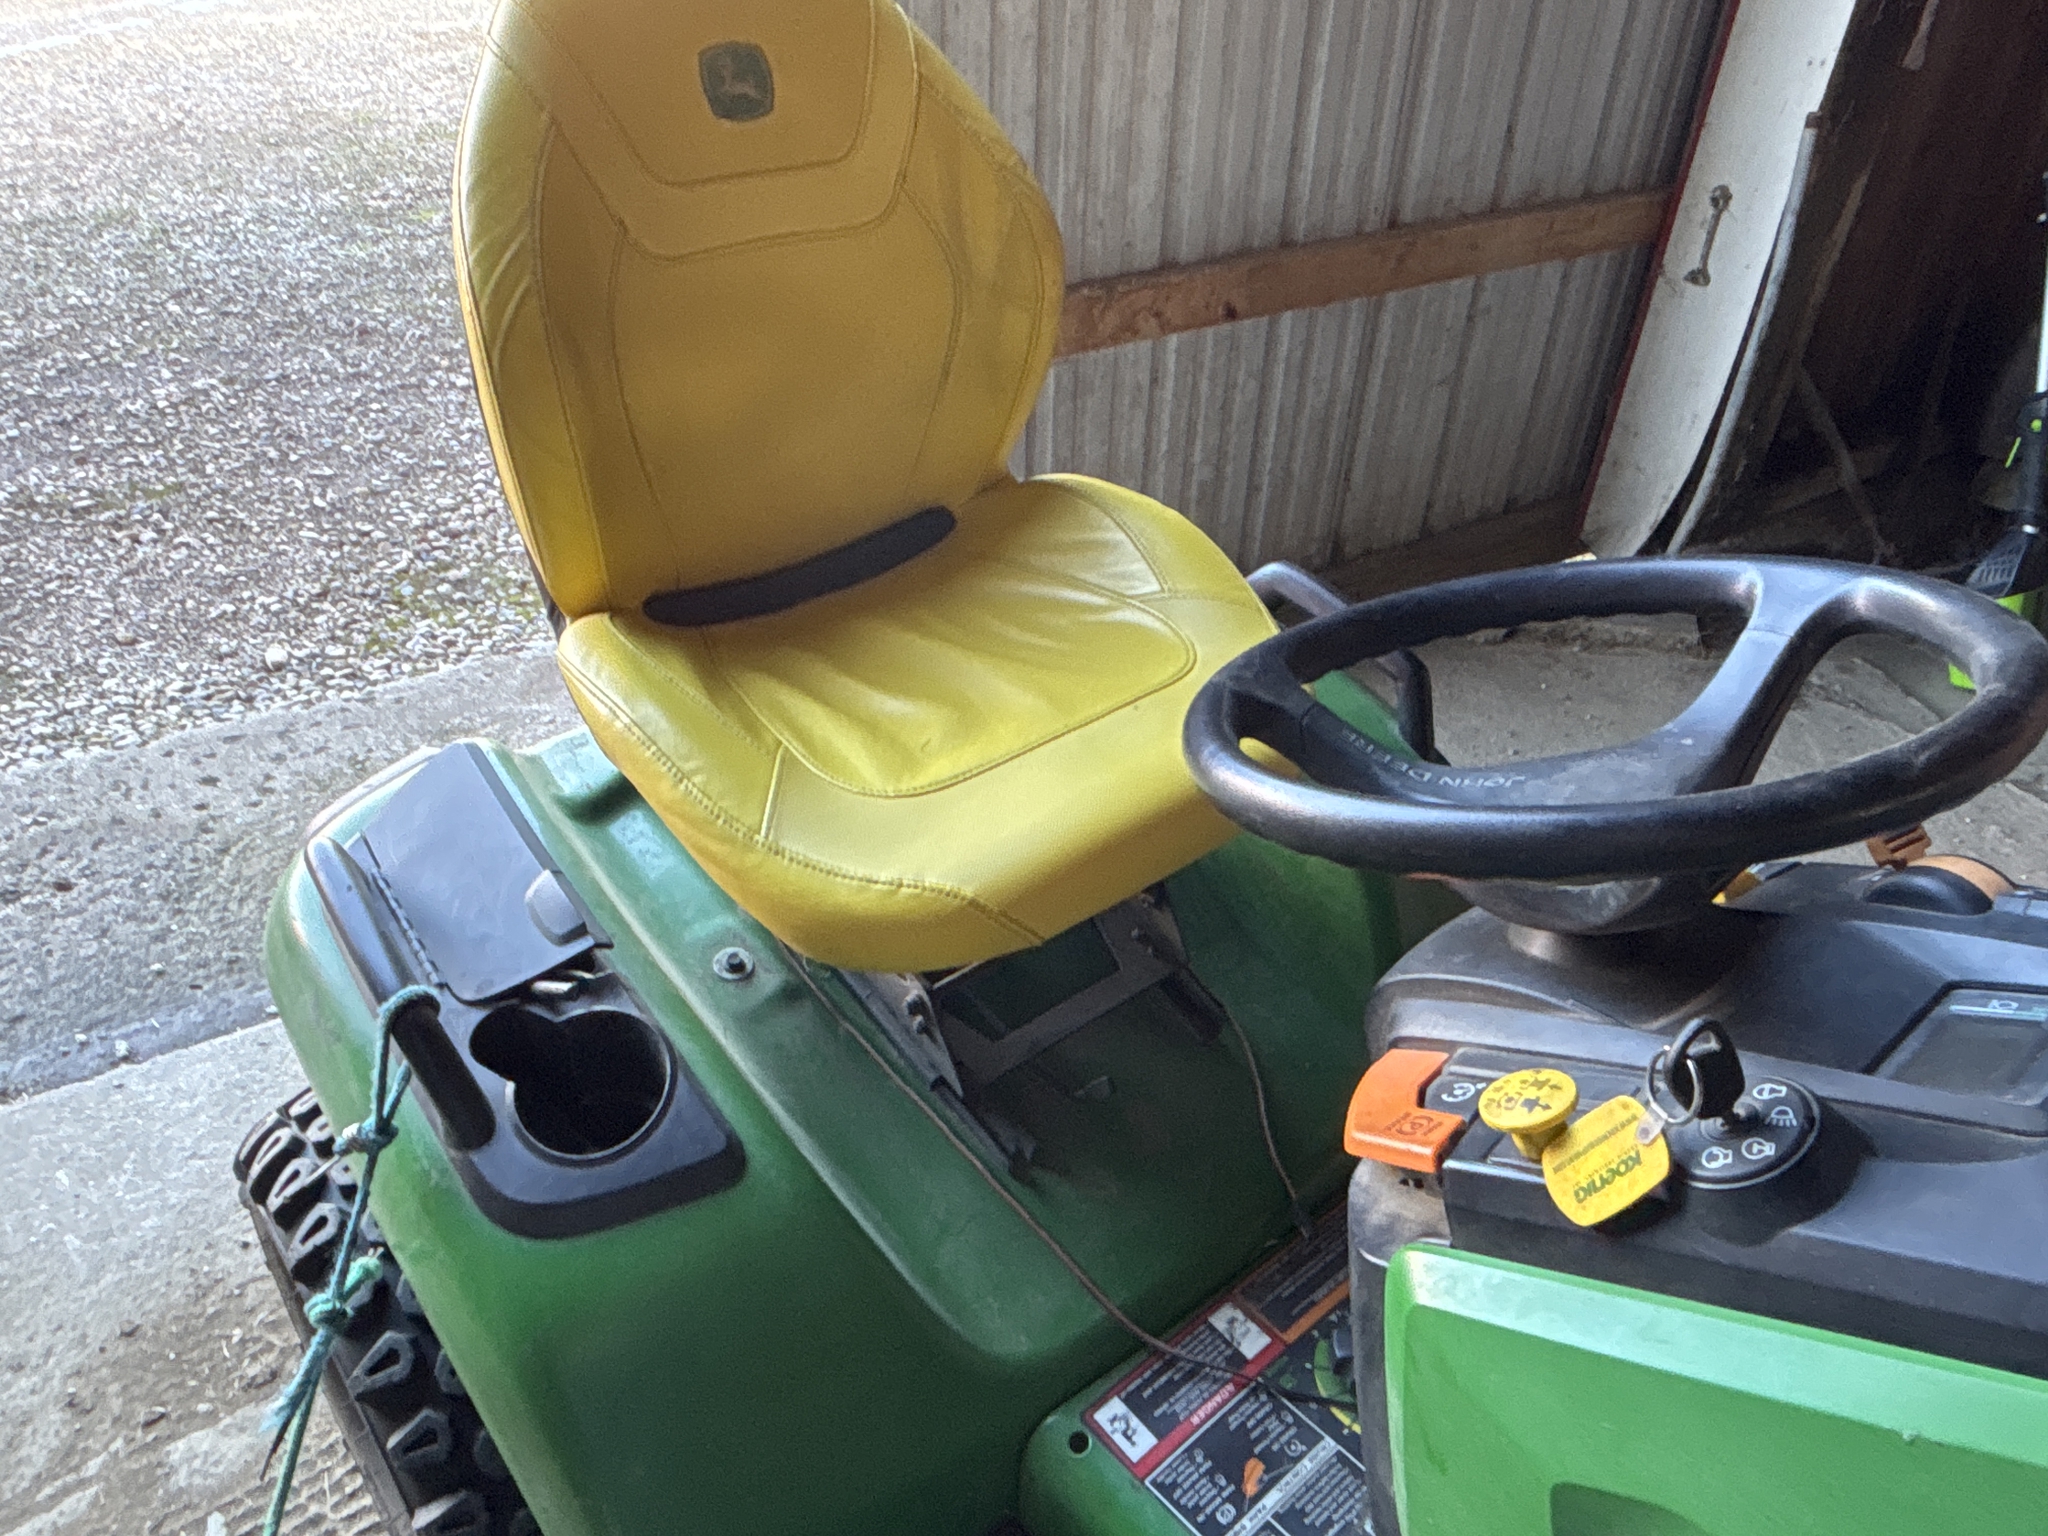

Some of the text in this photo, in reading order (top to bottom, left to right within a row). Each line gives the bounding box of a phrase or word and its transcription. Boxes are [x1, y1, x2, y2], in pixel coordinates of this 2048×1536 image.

[1339, 728, 1526, 788] JOHN DEERE
[1188, 1386, 1230, 1426] DANGER
